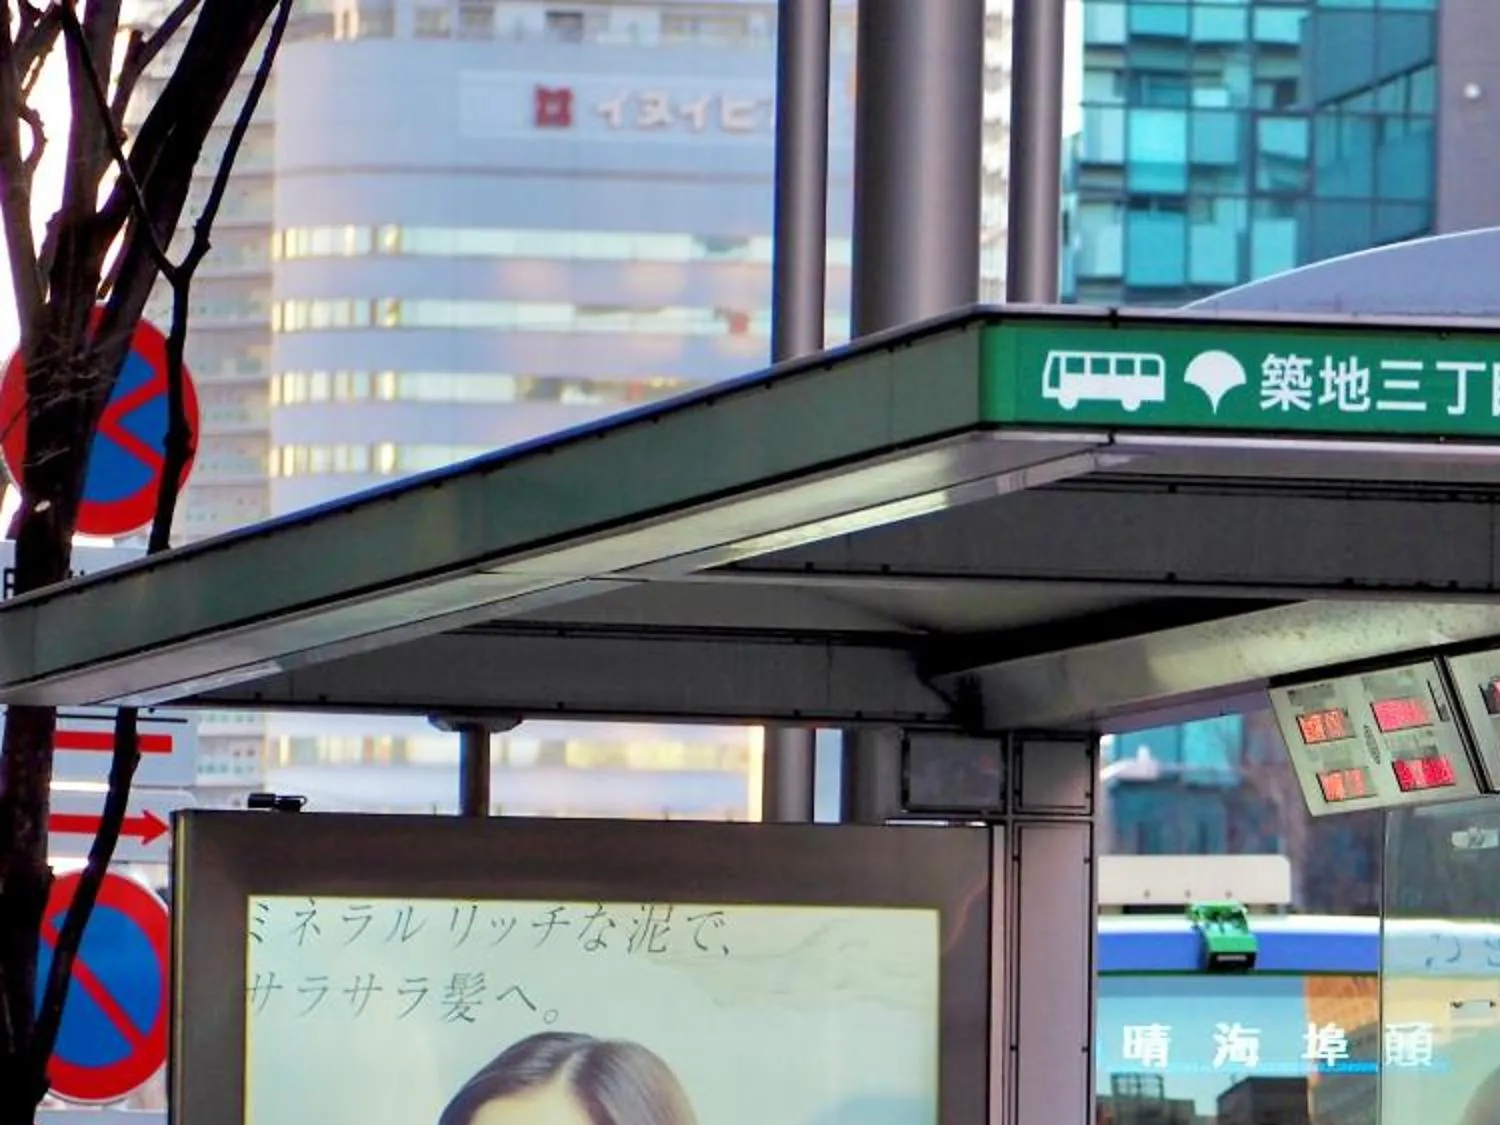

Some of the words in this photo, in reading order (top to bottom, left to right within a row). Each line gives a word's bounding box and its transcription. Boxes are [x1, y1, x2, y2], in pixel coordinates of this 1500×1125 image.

[594, 86, 776, 132] イヌイビ
[246, 972, 560, 1026] サラサラ髪へ。
[1122, 1023, 1434, 1068] 晴海埠頭
